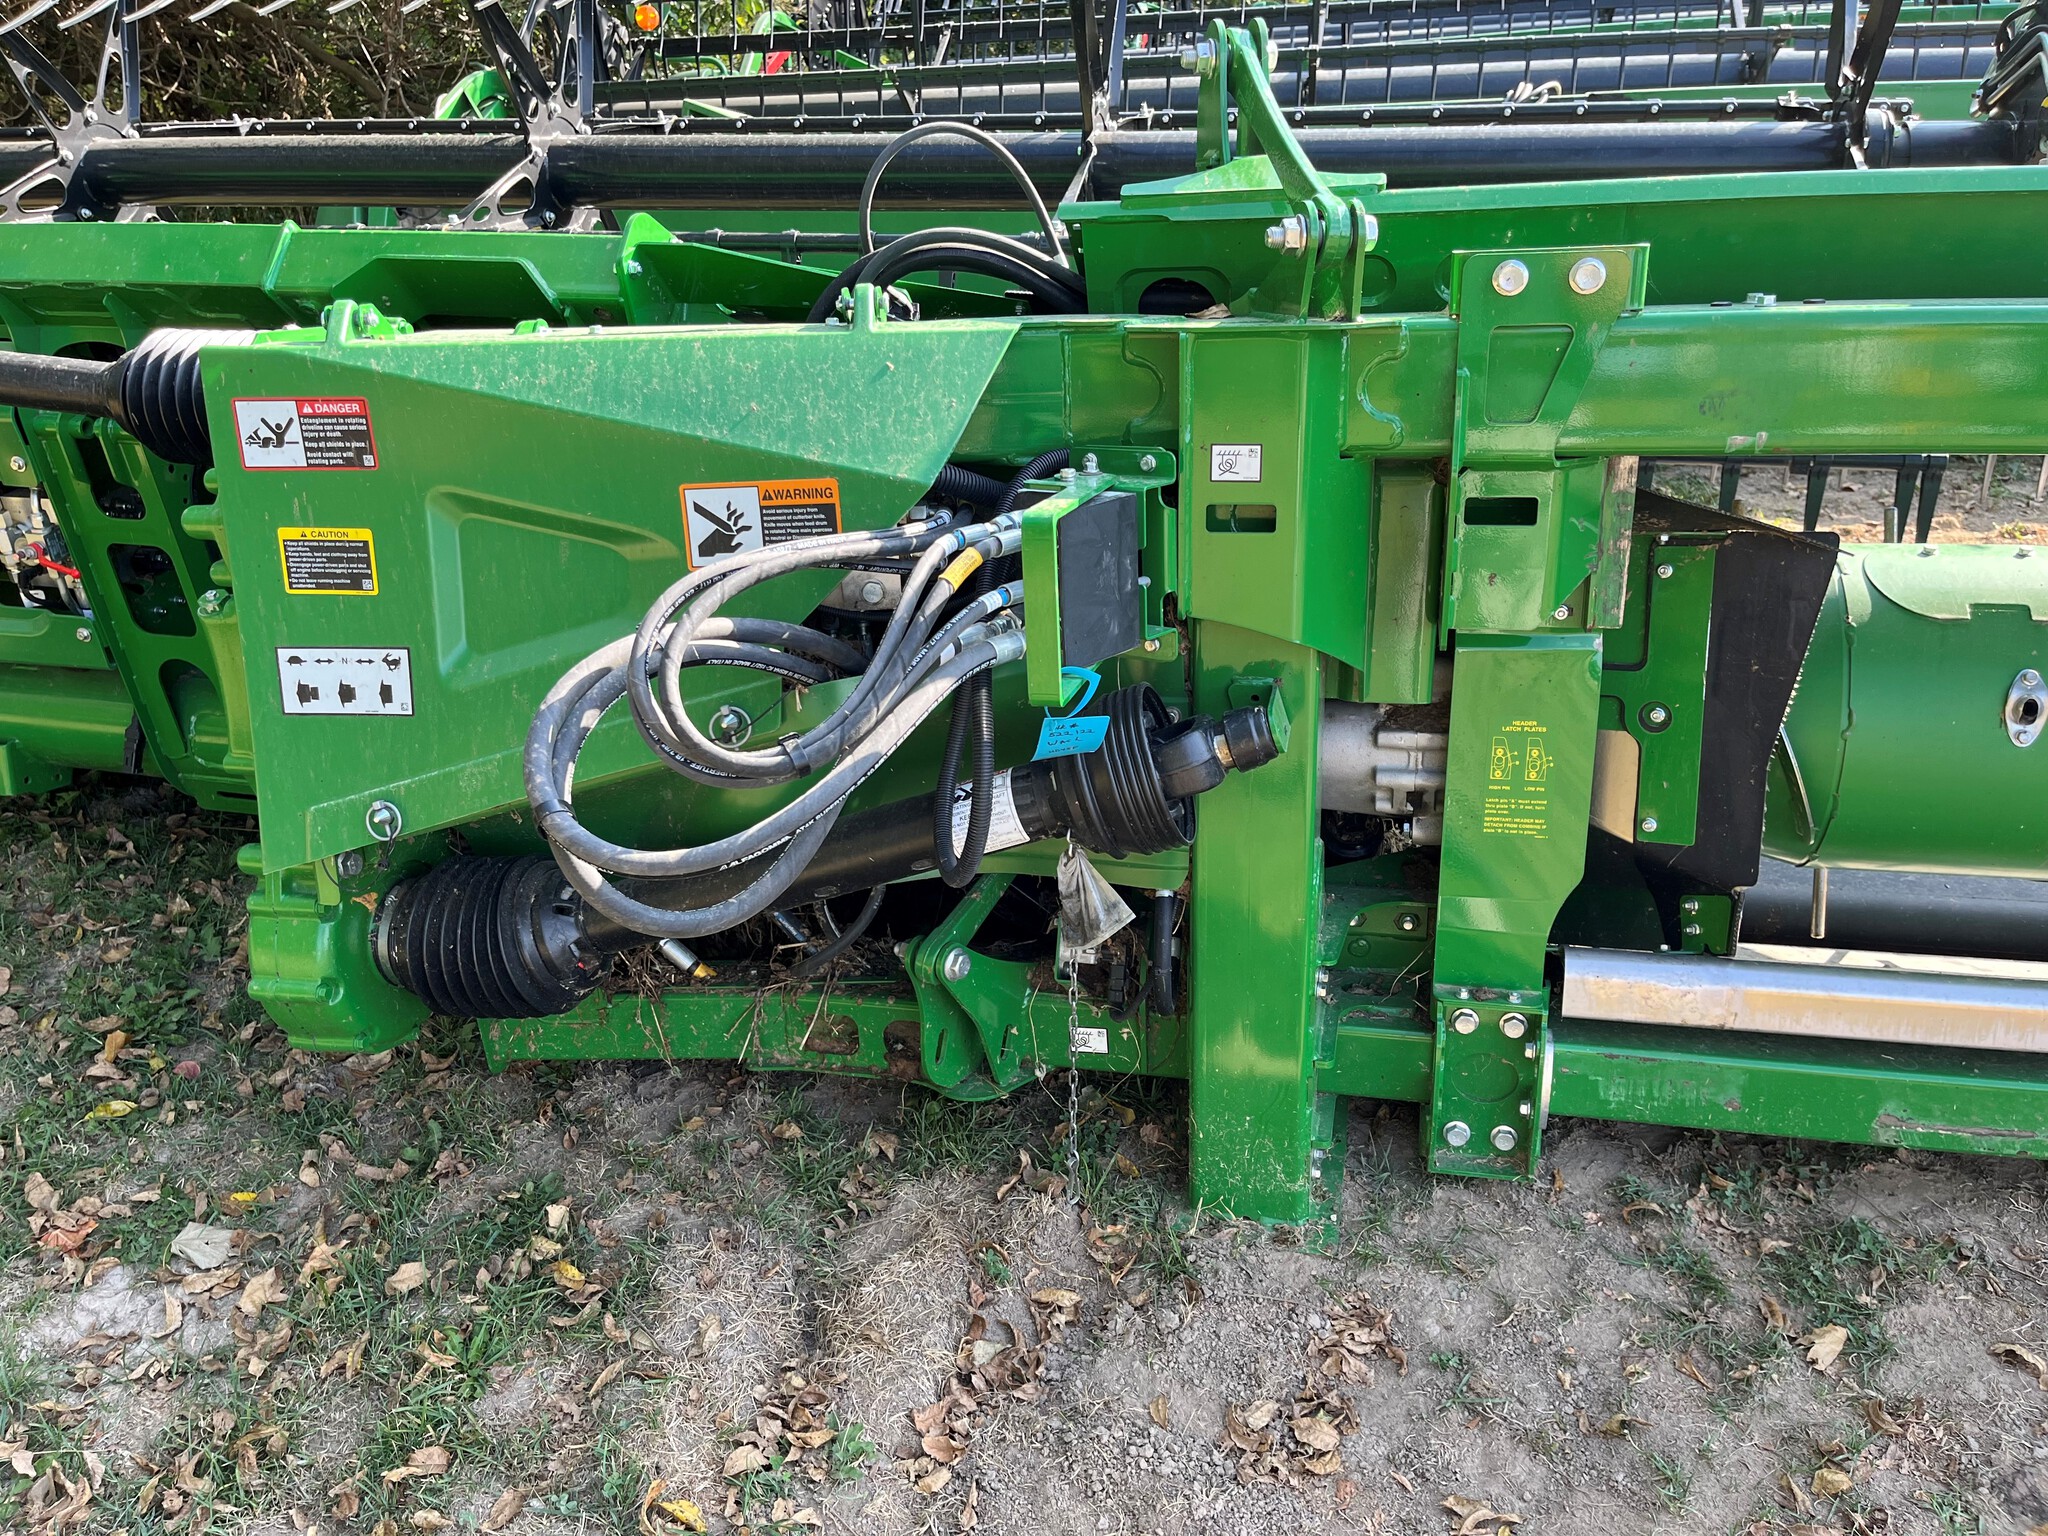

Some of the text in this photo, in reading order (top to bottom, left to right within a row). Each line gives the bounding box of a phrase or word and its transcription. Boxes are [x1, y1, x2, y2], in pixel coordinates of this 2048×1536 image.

[314, 404, 360, 413] DANGER
[773, 487, 833, 500] WARNING
[728, 835, 792, 868] ALFAGOMMA
